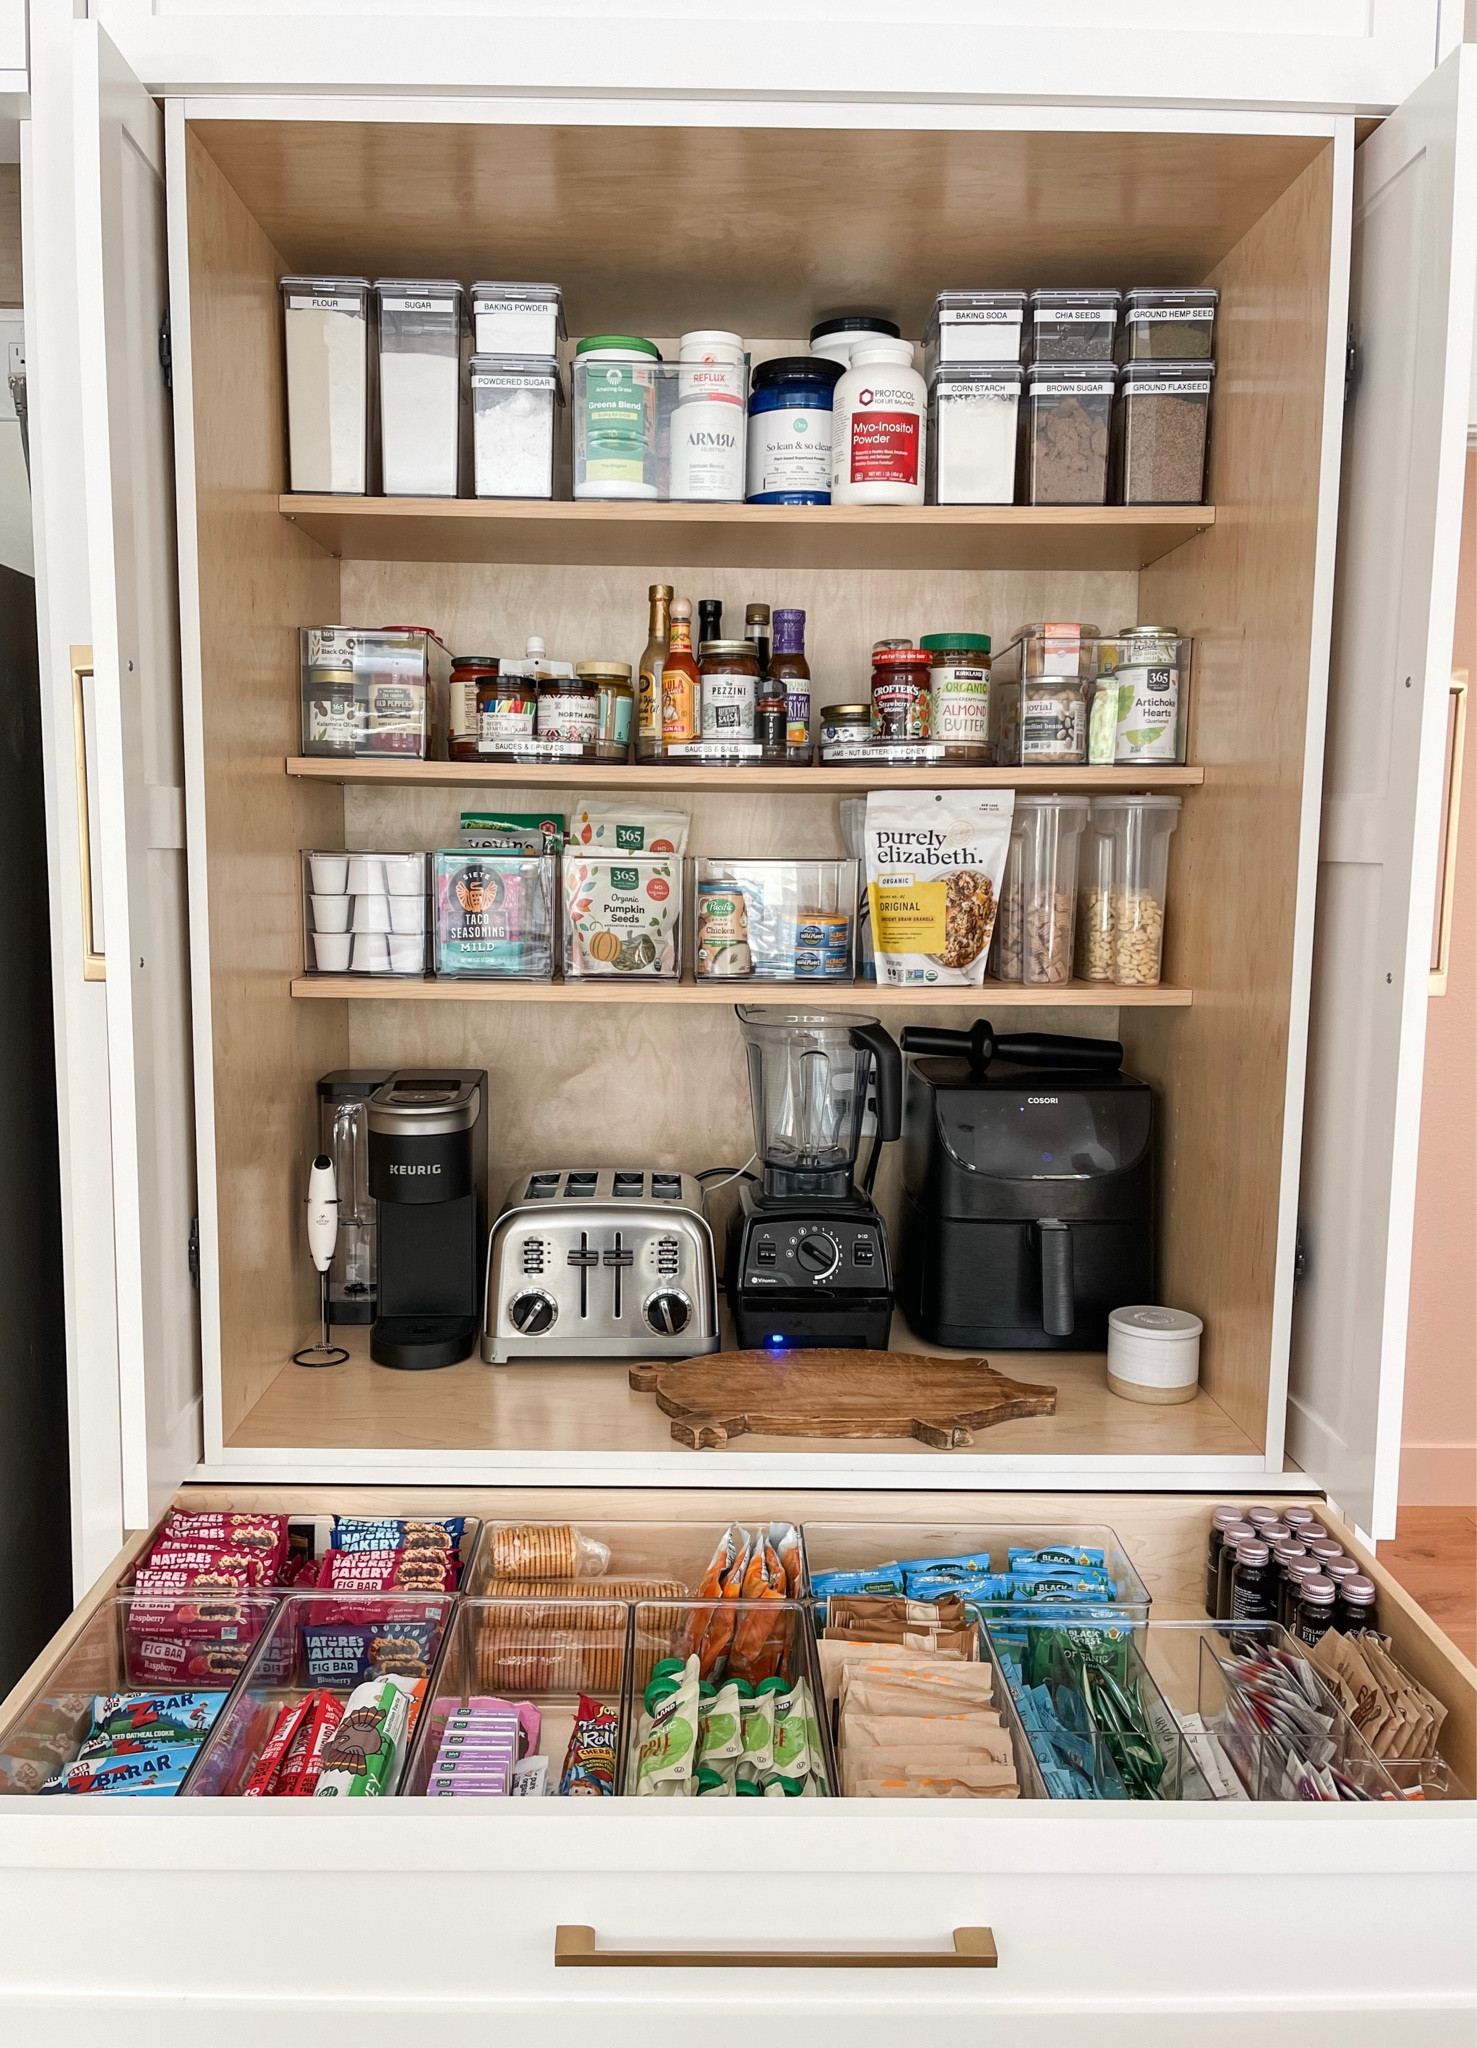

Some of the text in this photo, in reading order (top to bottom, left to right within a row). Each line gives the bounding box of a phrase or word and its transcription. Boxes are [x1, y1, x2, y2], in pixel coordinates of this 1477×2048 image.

[312, 299, 338, 308] FLOUR
[404, 301, 432, 309] SUGAR
[484, 302, 548, 312] BAKING POWDER
[956, 312, 985, 320] BAKING
[1055, 311, 1101, 319] CHIA SEEDS
[1134, 309, 1214, 318] GROUND HEMP SEED
[478, 377, 550, 386] POWDERED SUGAR
[693, 373, 725, 383] REFLUX
[595, 386, 618, 394] Amazing
[951, 384, 1006, 392] CORN STARCH
[1046, 384, 1103, 392] BROWN SUGAR
[1133, 383, 1208, 392] GROUND FLAXSEED
[874, 389, 915, 400] PROTOCOL
[588, 400, 642, 410] Greens Blend
[853, 422, 914, 434] Myo-Inositol
[853, 434, 890, 446] Powder
[766, 443, 776, 452] So
[776, 442, 793, 451] lean
[795, 441, 803, 450] &
[321, 648, 337, 656] Black
[1149, 672, 1169, 684] 365
[712, 686, 746, 696] PEZZINI
[874, 684, 919, 696] CROFTER'S
[946, 682, 988, 692] ORGANIC
[878, 700, 911, 711] Strawberry
[1135, 698, 1176, 707] Artichoke
[942, 704, 986, 717] ALMOND
[1026, 702, 1052, 715] jovial
[1143, 708, 1172, 717] Hearts
[718, 712, 738, 723] SALSA
[944, 718, 985, 732] BUTTER
[530, 744, 564, 752] SPREADS
[831, 750, 844, 758] JAMS
[618, 829, 641, 842] 365
[876, 829, 947, 849] purely
[877, 847, 983, 865] elizabeth.
[462, 871, 491, 881] SIETE
[613, 870, 636, 881] 365
[882, 877, 910, 885] ORGANIC
[611, 893, 640, 904] Organic
[603, 904, 645, 915] Pumpkin
[708, 901, 733, 911] Pacific
[880, 902, 920, 912] ORIGINAL
[465, 913, 489, 925] TACO
[611, 914, 640, 924] Seeds
[451, 925, 505, 939] SEASONING
[706, 926, 735, 934] Chicken
[460, 942, 495, 952] MILD
[389, 1164, 442, 1175] KEURIG
[341, 1531, 400, 1545] NATURE'S
[150, 1552, 212, 1566] NATURE'S
[1042, 1554, 1071, 1564] BLACK
[336, 1580, 378, 1590] FIG BAR
[1038, 1583, 1068, 1592] BLACK
[129, 1613, 166, 1624] Raspberry
[1067, 1629, 1101, 1638] BLACK
[1302, 1626, 1328, 1636] COLLAGE
[306, 1636, 364, 1648] ATURE'S
[144, 1644, 183, 1660] FIG BAR
[307, 1647, 364, 1660] AKERY
[144, 1660, 178, 1675] Raspberry
[312, 1661, 354, 1672] FIG BAR
[317, 1676, 352, 1685] Blueberry
[385, 1711, 397, 1733] Nutrition
[578, 1719, 618, 1733] Fruit
[126, 1731, 153, 1739] OATMEAL
[581, 1731, 615, 1749] Roll
